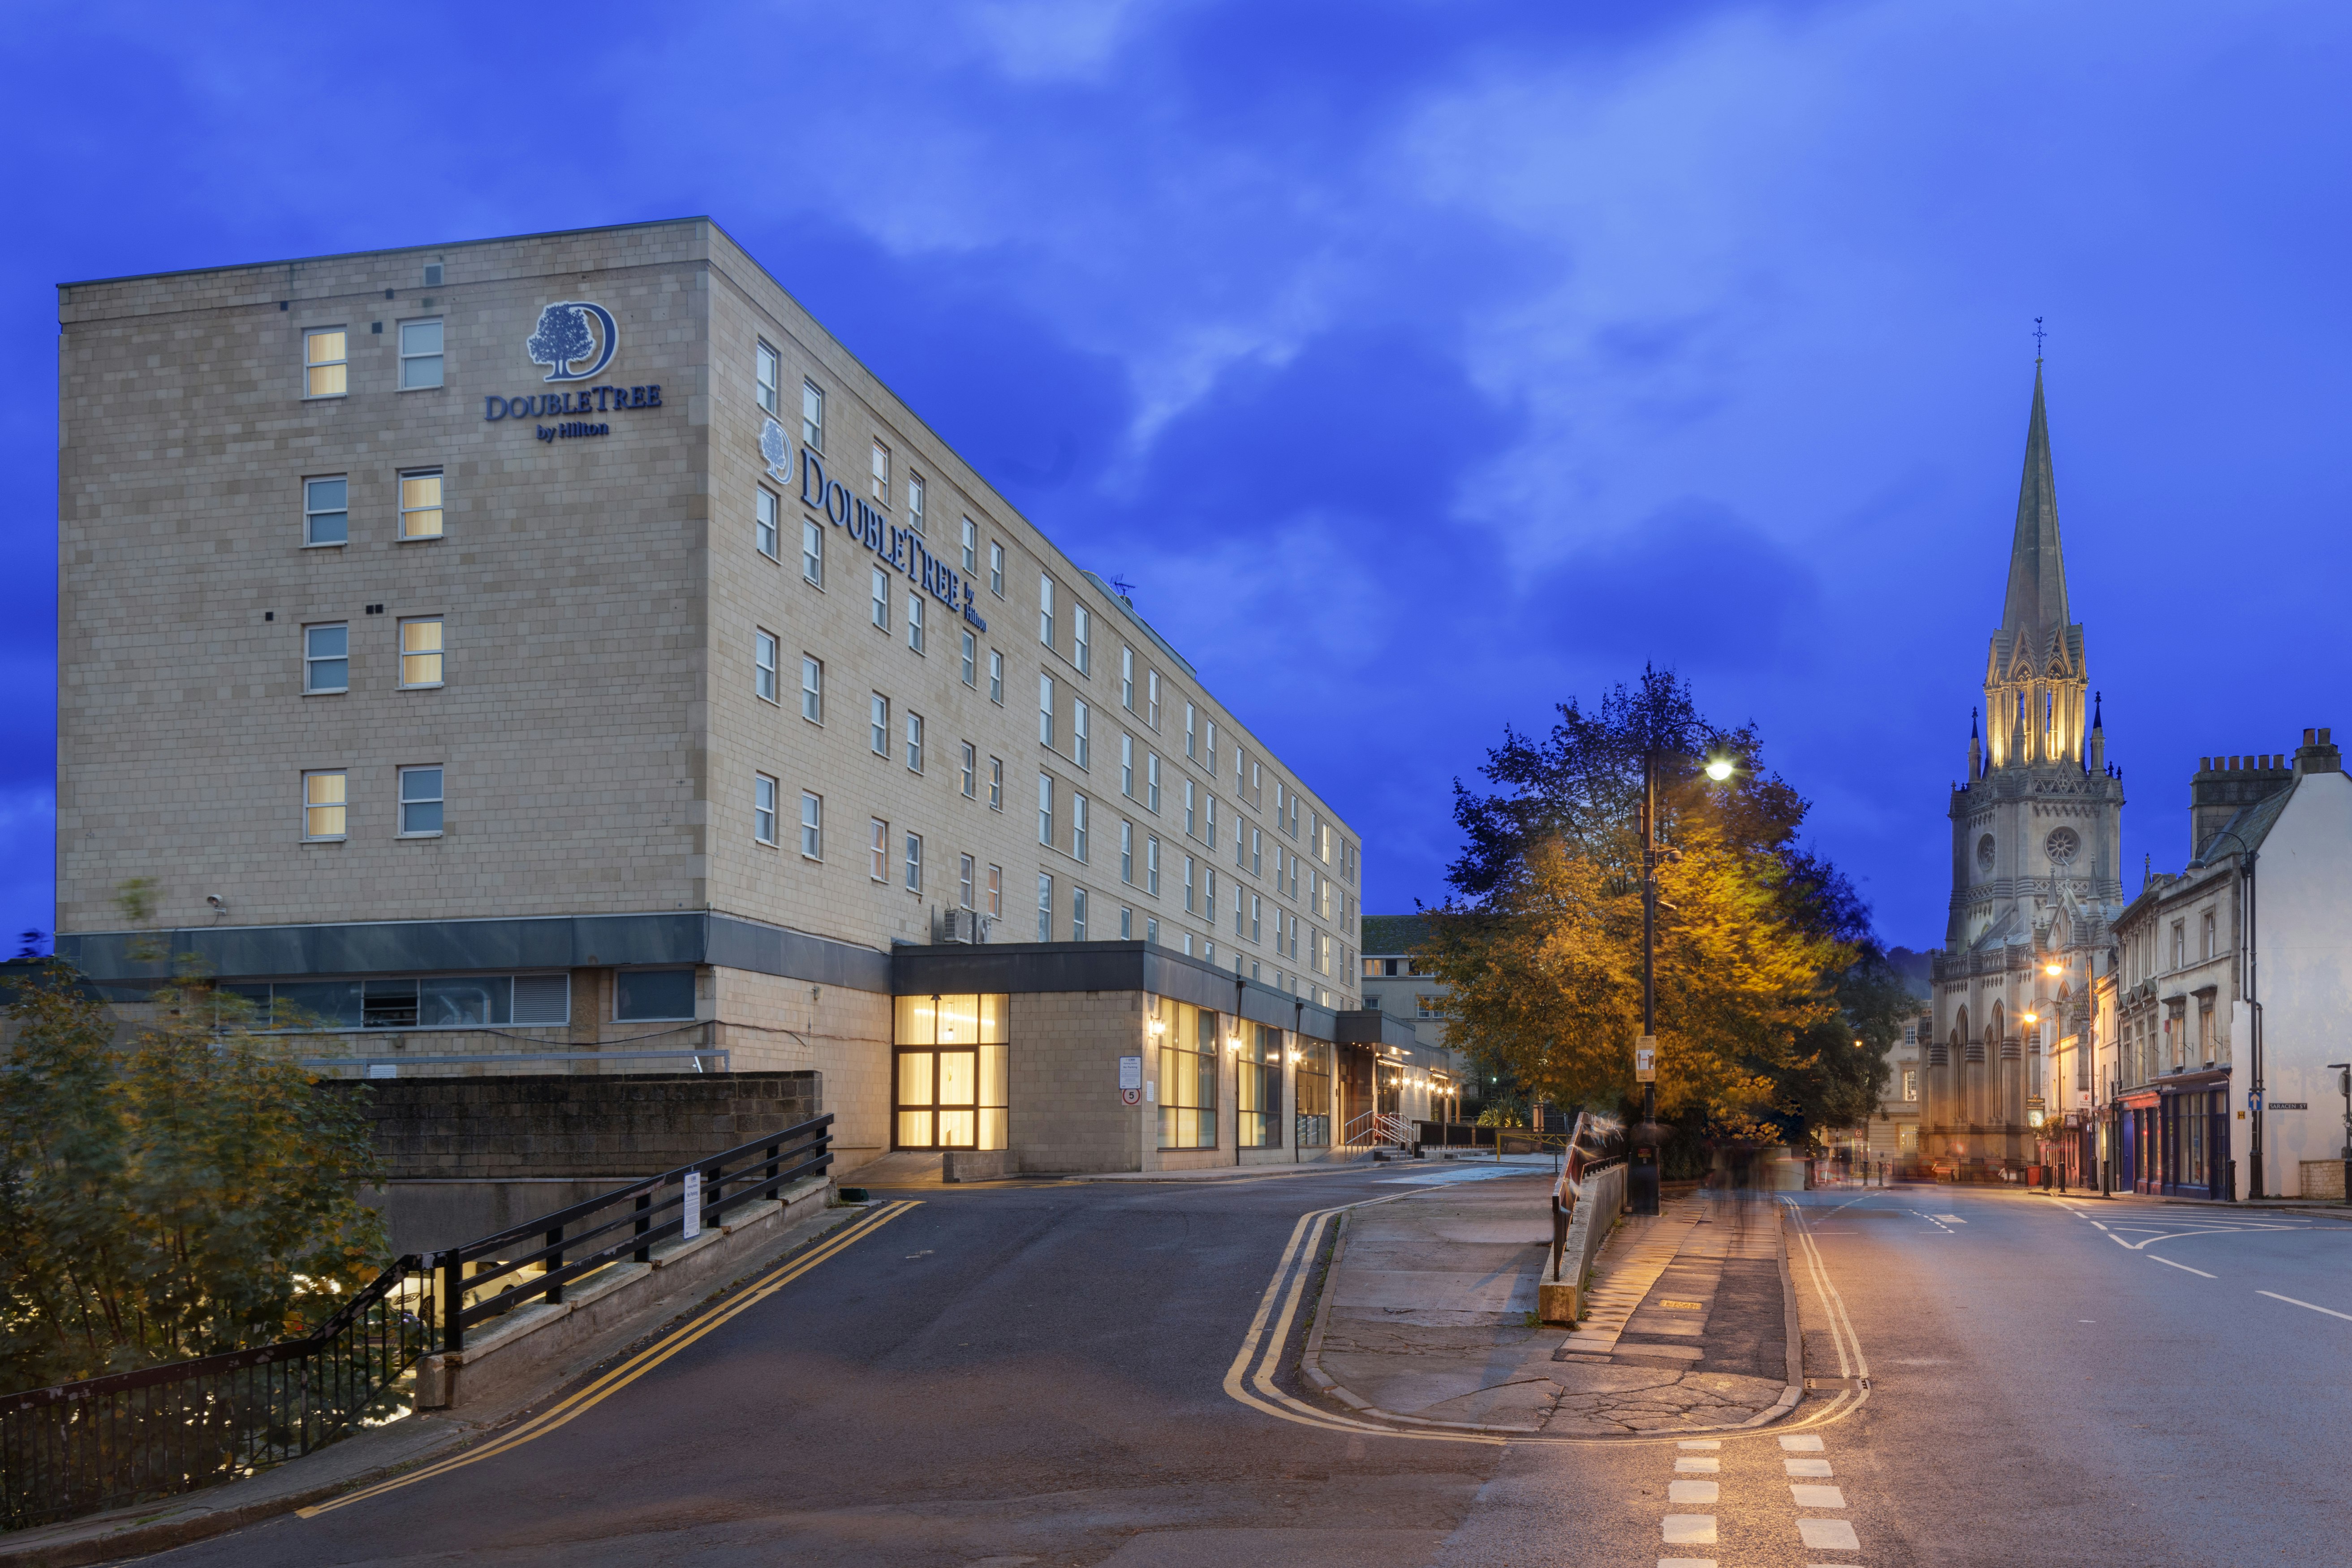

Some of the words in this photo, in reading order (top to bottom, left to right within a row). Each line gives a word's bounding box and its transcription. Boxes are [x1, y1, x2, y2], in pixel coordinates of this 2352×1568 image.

[537, 424, 556, 443] by
[558, 421, 609, 438] Hilton
[965, 582, 974, 605] by
[965, 603, 987, 633] Hilton
